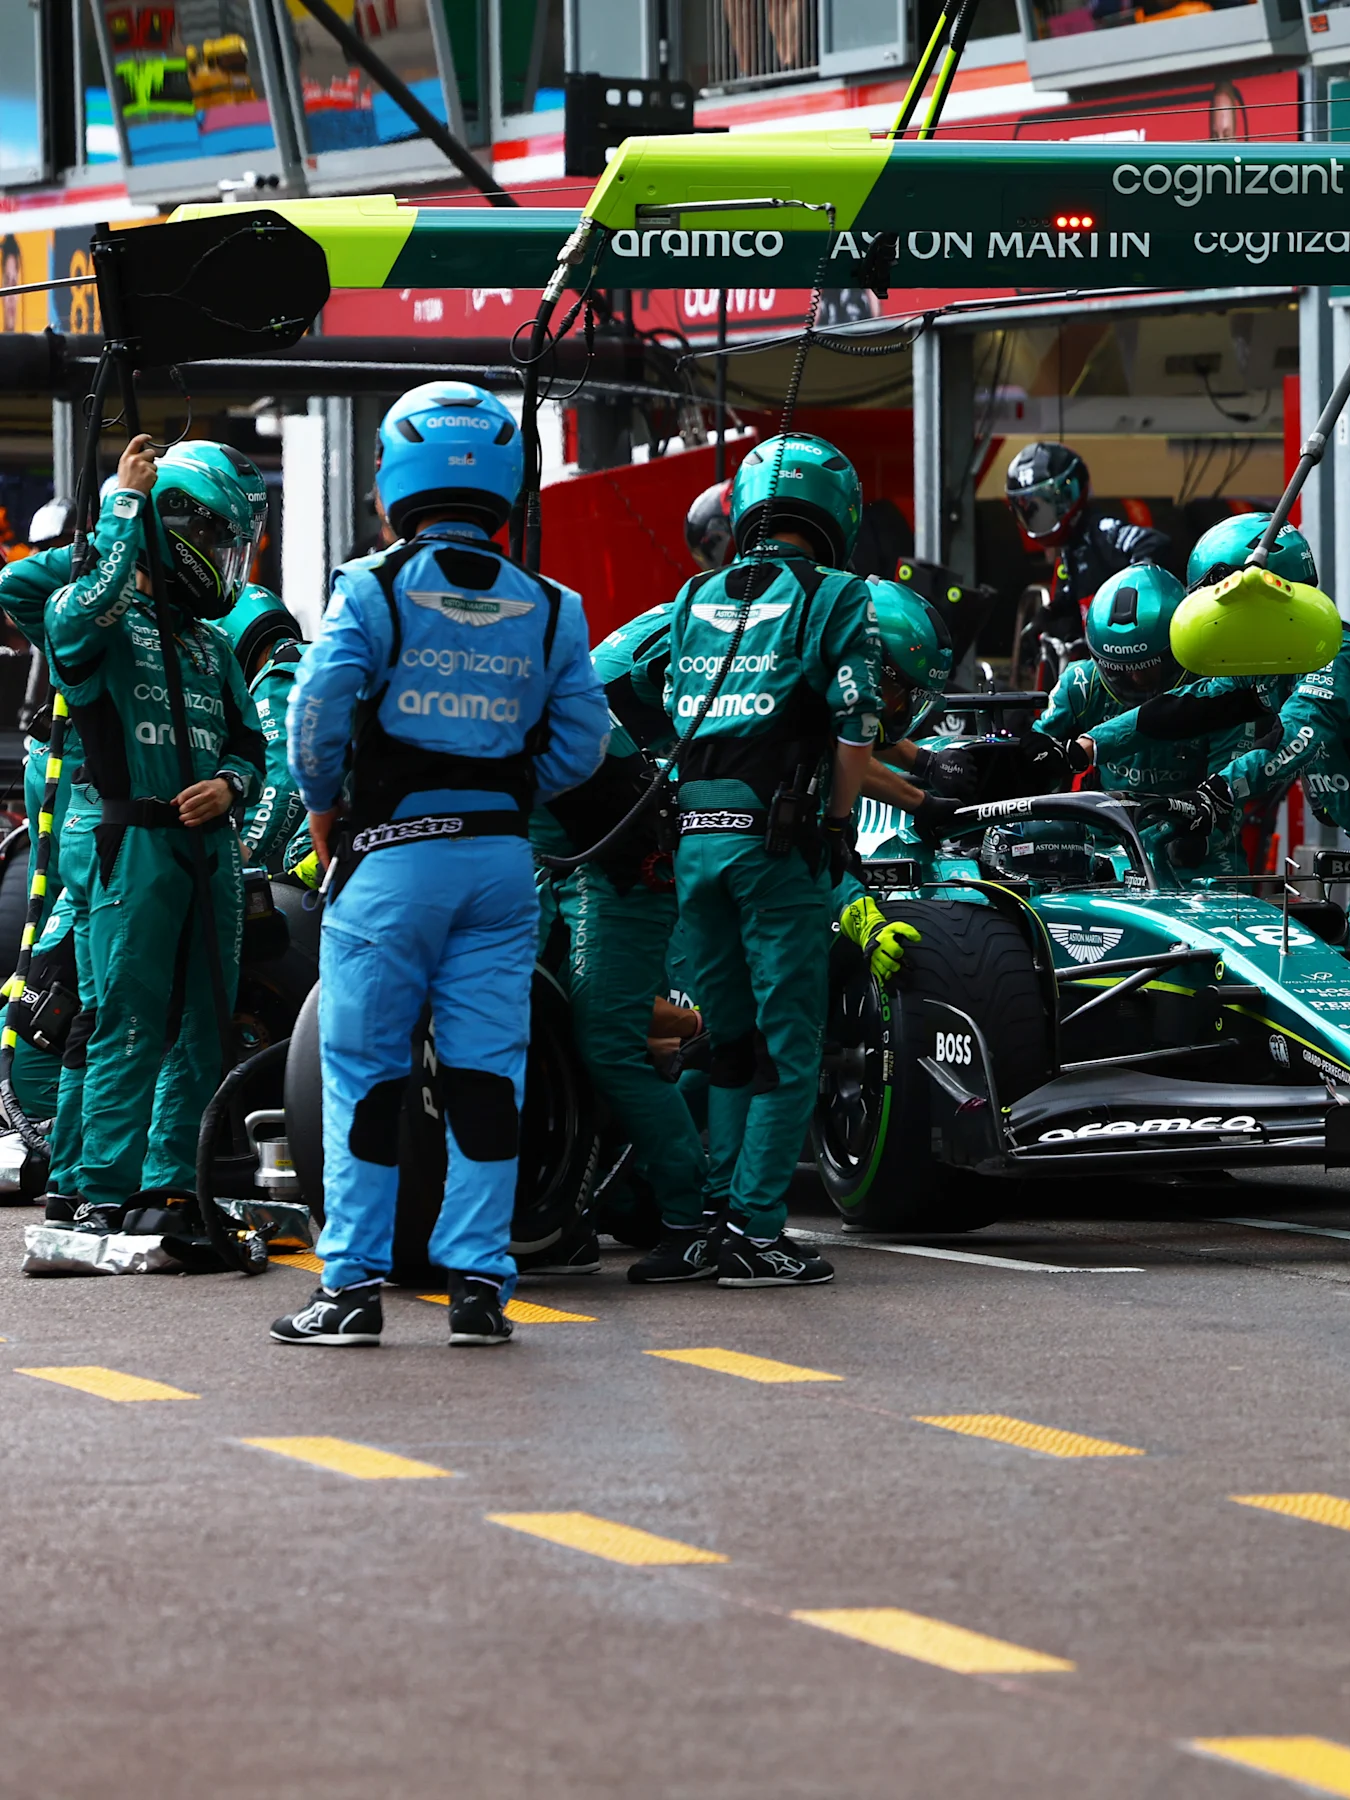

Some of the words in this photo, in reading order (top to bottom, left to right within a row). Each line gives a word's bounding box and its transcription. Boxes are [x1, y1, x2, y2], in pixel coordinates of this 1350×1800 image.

[1113, 156, 1343, 207] cognizant
[611, 230, 784, 258] aramco
[988, 231, 1151, 258] MARTIN
[427, 416, 490, 430] aramco
[175, 542, 214, 589] cognizant
[1102, 642, 1148, 655] aramco
[402, 649, 532, 678] cognizant
[1125, 657, 1162, 673] MARTIN
[398, 690, 520, 724] aramco
[976, 799, 1036, 821] juniper
[352, 817, 463, 852] alpinestars
[1035, 843, 1060, 851] ASTON
[1061, 843, 1085, 851] MARTIN
[233, 908, 243, 965] ASTON
[573, 918, 588, 976] ASTON
[1068, 933, 1085, 943] ASTON
[1085, 934, 1102, 945] MARTIN
[1208, 925, 1316, 947] 18
[935, 1031, 972, 1065] BOSS
[1037, 1115, 1257, 1143] aramco
